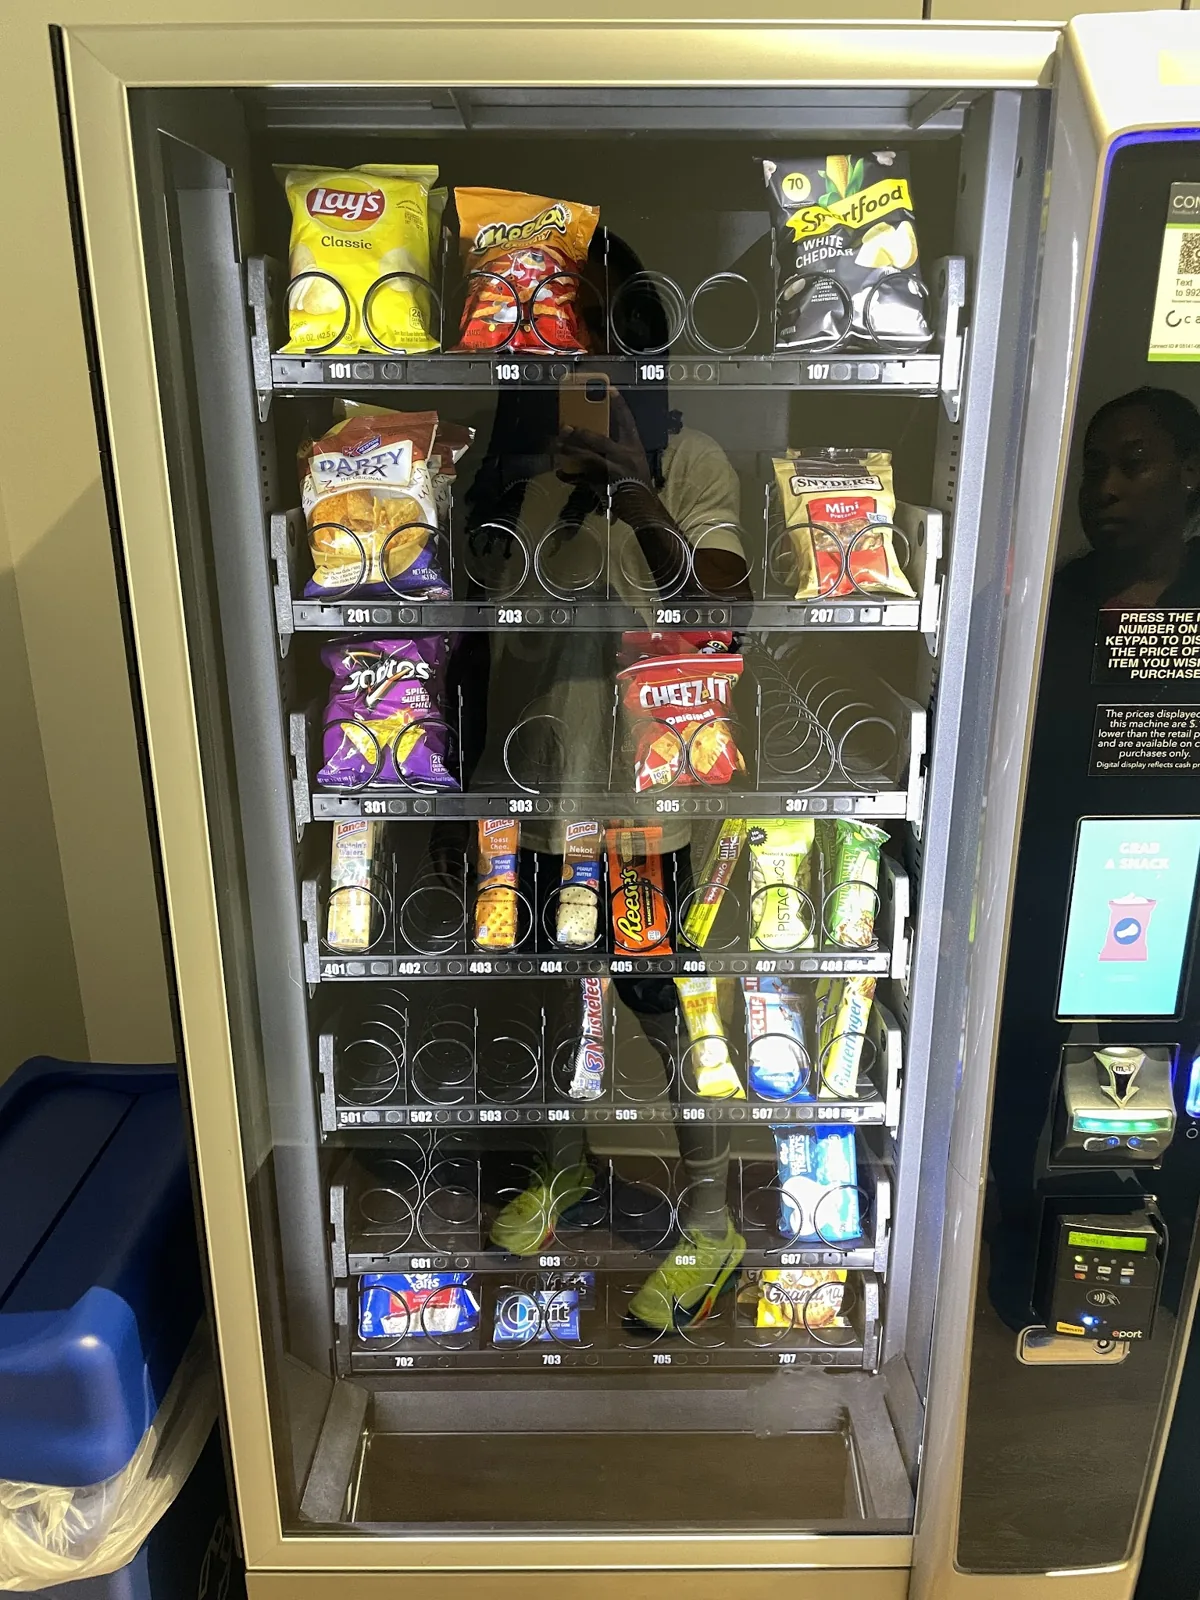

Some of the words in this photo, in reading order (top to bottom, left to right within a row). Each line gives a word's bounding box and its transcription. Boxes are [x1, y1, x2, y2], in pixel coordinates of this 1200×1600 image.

[788, 177, 804, 191] 70
[311, 188, 381, 221] Lay's
[321, 235, 373, 250] Classic
[802, 234, 844, 252] WHITE
[795, 247, 854, 269] CHEDDAR
[1175, 278, 1193, 287] Text
[1175, 289, 1184, 297] to
[328, 363, 351, 379] 101
[495, 364, 520, 380] 103
[640, 364, 665, 380] 105
[806, 364, 830, 380] 107
[319, 447, 404, 472] PARTY
[797, 477, 875, 488] SNYDER'S
[825, 501, 859, 514] Mini
[829, 511, 857, 519] Pretzels
[347, 608, 370, 623] 201
[498, 608, 523, 624] 203
[656, 608, 681, 624] 205
[810, 608, 834, 624] 207
[1120, 612, 1164, 623] PRESS
[1167, 612, 1194, 622] THE
[1118, 624, 1175, 634] NUMBER
[1177, 624, 1198, 634] ON
[1105, 635, 1158, 646] KEYPAD
[1161, 635, 1179, 645] TO
[1110, 647, 1136, 657] THE
[1139, 647, 1179, 657] PRICE
[1181, 647, 1200, 657] OF
[1108, 658, 1139, 668] ITEM
[1142, 658, 1170, 668] YOU
[1173, 658, 1200, 668] WIS
[1130, 669, 1200, 679] PURCHASE
[1105, 709, 1124, 718] The
[1125, 709, 1155, 720] prices
[1109, 719, 1127, 728] this
[1128, 719, 1170, 728] machine
[1098, 729, 1125, 738] lower
[1126, 729, 1148, 738] than
[1150, 729, 1166, 738] the
[1167, 729, 1192, 738] retail
[1097, 739, 1117, 748] and
[1135, 739, 1178, 748] available
[1118, 748, 1167, 759] purchases
[1168, 748, 1191, 760] only.
[1096, 761, 1120, 769] Digital
[1120, 761, 1147, 769] display
[364, 799, 386, 813] 301
[509, 799, 533, 813] 303
[656, 799, 680, 813] 305
[785, 799, 808, 812] 307
[337, 820, 366, 835] Lance
[568, 823, 596, 836] Lance
[1119, 842, 1160, 855] GRAB
[1104, 858, 1115, 870] A
[1119, 857, 1170, 870] SNACK
[324, 963, 345, 975] 401
[398, 962, 421, 974] 402
[469, 961, 492, 973] 403
[540, 961, 563, 973] 404
[610, 960, 633, 972] 405
[683, 960, 706, 972] 406
[755, 960, 777, 972] 407
[585, 1051, 604, 1072] 3
[340, 1112, 361, 1123] 501
[410, 1111, 433, 1123] 502
[479, 1110, 502, 1122] 503
[548, 1109, 570, 1121] 504
[615, 1109, 638, 1121] 505
[683, 1108, 705, 1120] 506
[752, 1107, 773, 1120] 507
[411, 1257, 431, 1269] 601
[539, 1256, 561, 1267] 603
[675, 1255, 696, 1266] 605
[780, 1253, 801, 1265] 607
[363, 1310, 373, 1324] 2
[1112, 1330, 1143, 1339] eport
[394, 1356, 414, 1368] 702
[541, 1354, 561, 1365] 703
[652, 1354, 672, 1365] 705
[778, 1353, 797, 1364] 707
